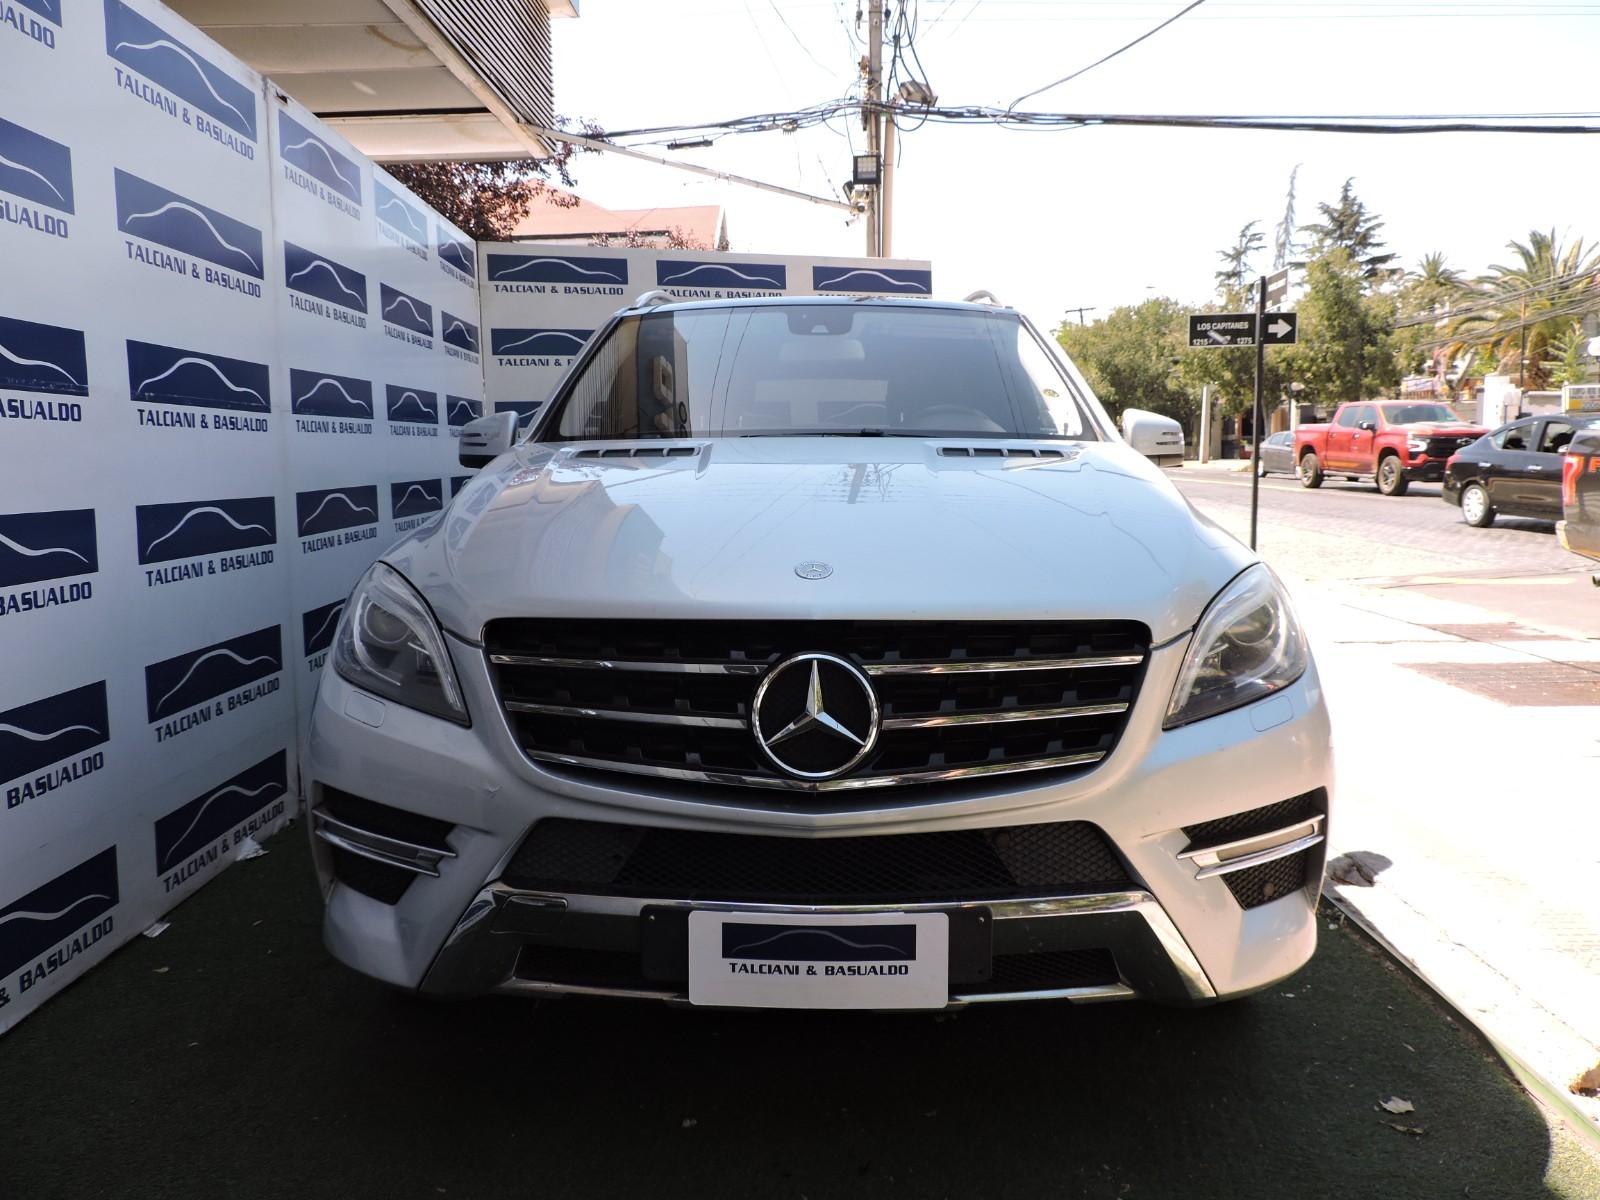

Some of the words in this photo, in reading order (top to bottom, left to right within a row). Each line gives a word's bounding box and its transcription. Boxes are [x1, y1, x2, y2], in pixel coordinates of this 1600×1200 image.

[114, 67, 177, 118] TALCIANI
[182, 107, 191, 126] &
[196, 115, 254, 160] BASUALDO
[125, 241, 186, 275] TALCIANI
[192, 263, 200, 279] &
[205, 267, 261, 298] BASUALDO
[494, 284, 546, 294] TALCIANI
[550, 286, 559, 294] &
[563, 286, 624, 296] BASUALDO
[715, 291, 721, 299] &
[289, 294, 325, 316] TALCIANI
[325, 306, 331, 318] &
[333, 308, 367, 329] BASUALDO
[1212, 321, 1249, 330] CAPITANES
[497, 358, 549, 367] TALCIANI
[554, 359, 562, 367] &
[137, 409, 195, 428] TALCIANI
[201, 414, 209, 429] &
[214, 415, 268, 432] BASUALDO
[296, 420, 329, 433] TALCIANI
[331, 421, 337, 434] &
[339, 422, 372, 434] BASUALDO
[302, 535, 335, 554] TALCIANI
[337, 534, 342, 546] &
[344, 527, 377, 544] BASUALDO
[145, 562, 203, 587] TALCIANI
[208, 560, 216, 575] &
[220, 550, 274, 572] BASUALDO
[154, 706, 211, 743] TALCIANI
[215, 702, 224, 717] &
[227, 677, 280, 711] BASUALDO
[7, 752, 104, 810] BASUALDO
[163, 846, 218, 893] TALCIANI
[221, 839, 230, 853] &
[19, 916, 113, 993] BASUALDO
[729, 962, 799, 976] TALCIANI
[806, 965, 818, 976] &
[824, 965, 909, 977] BASUALDO
